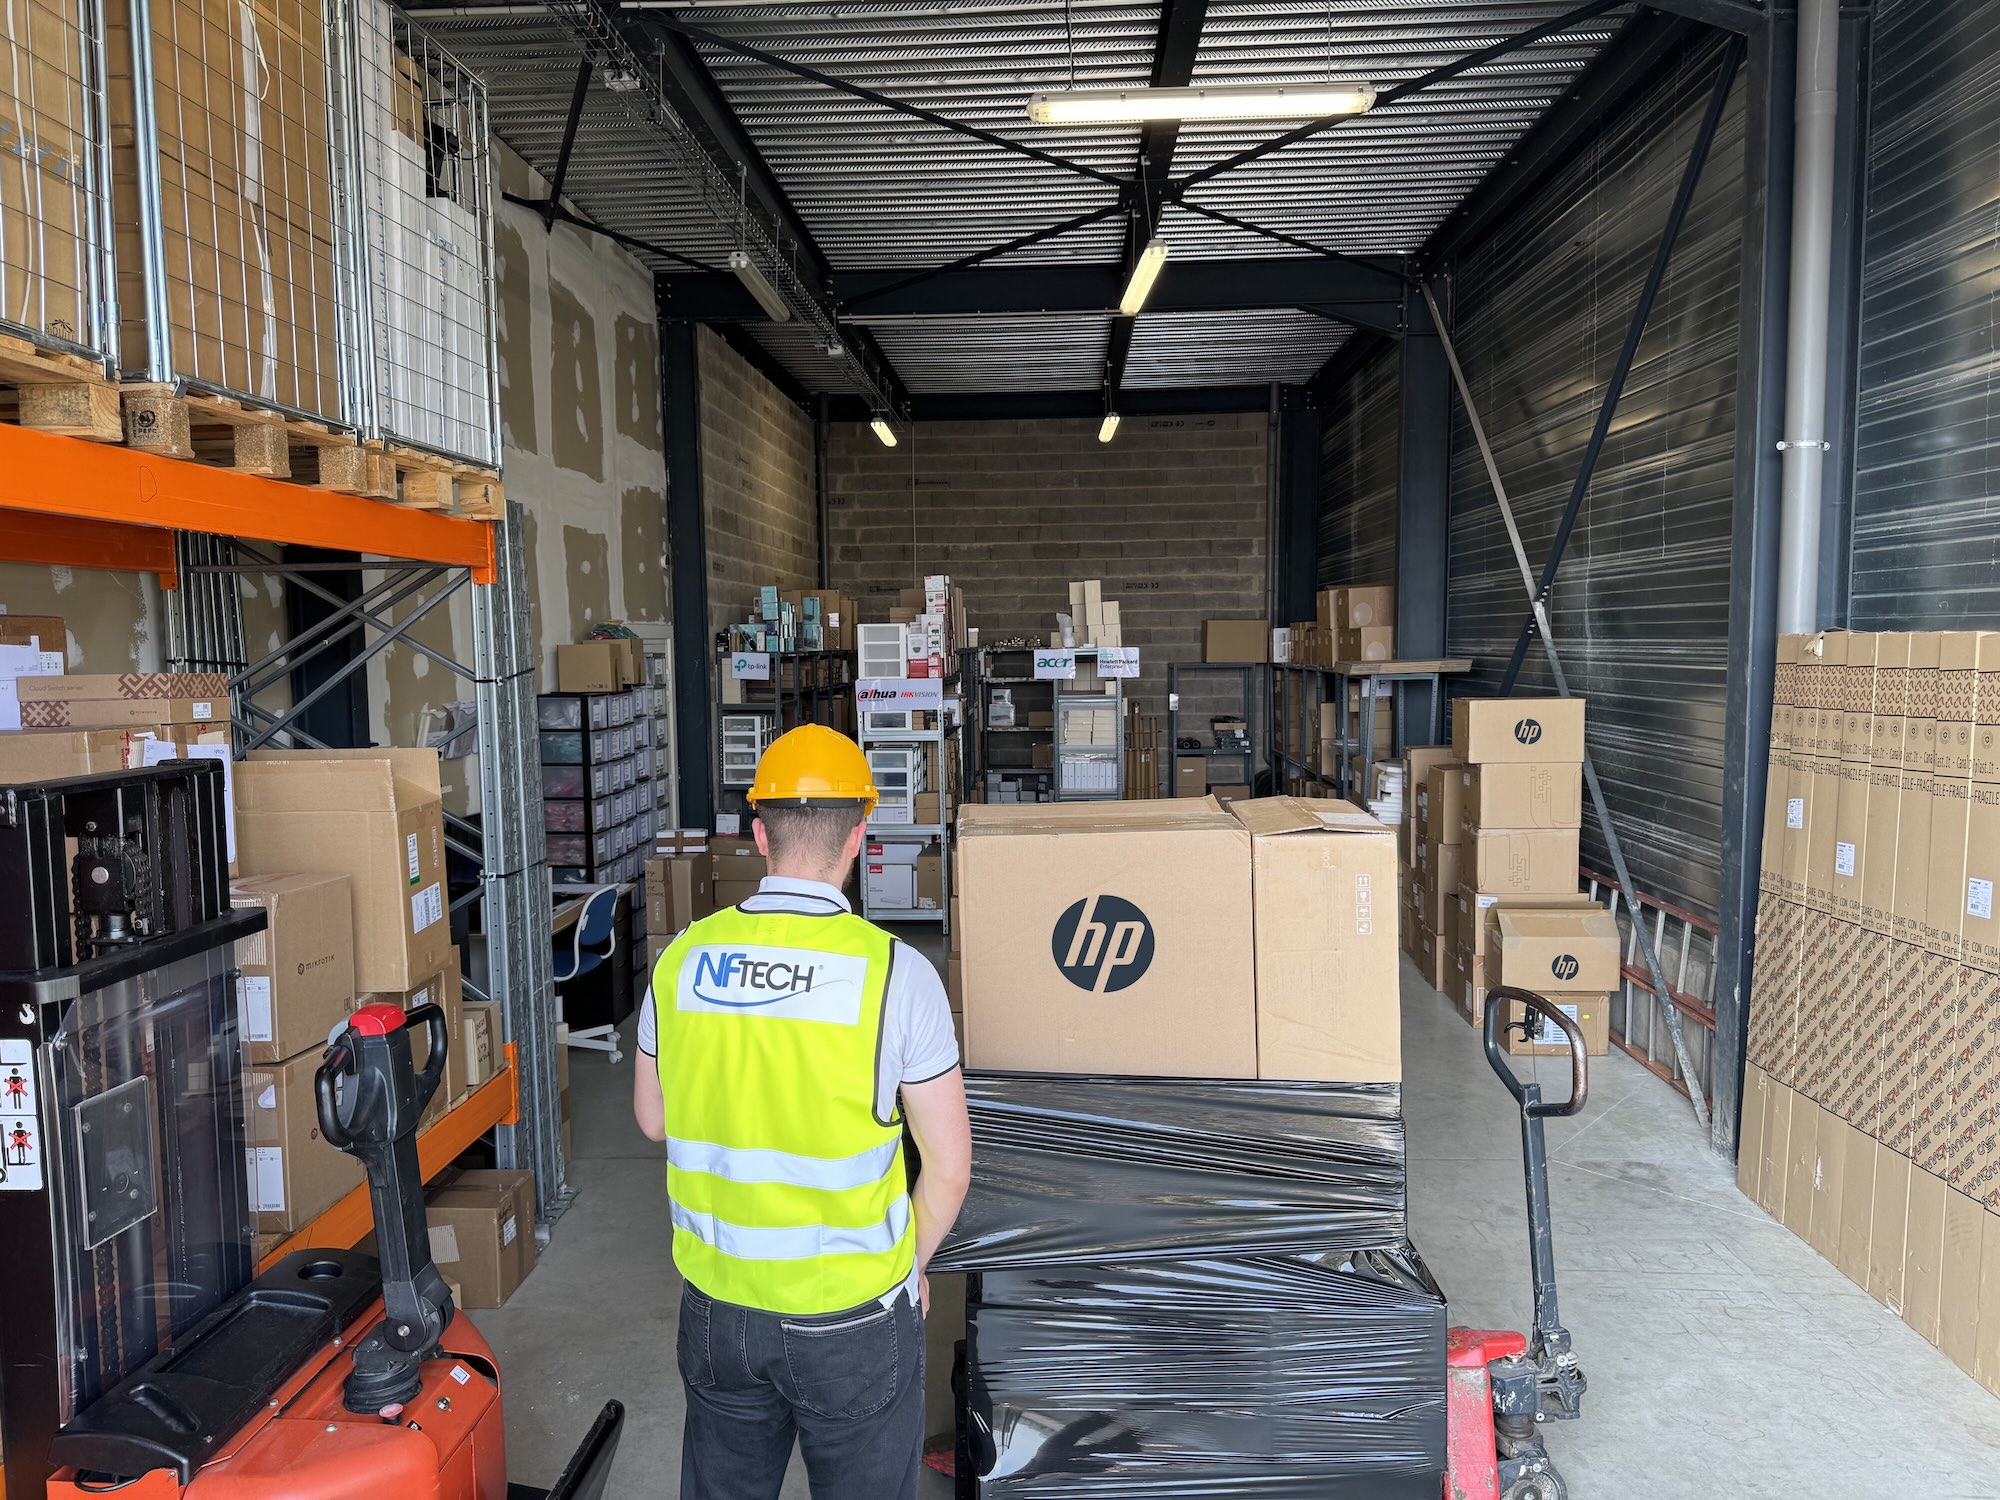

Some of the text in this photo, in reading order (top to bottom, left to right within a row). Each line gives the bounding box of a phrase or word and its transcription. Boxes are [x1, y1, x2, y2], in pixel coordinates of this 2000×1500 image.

[1037, 658, 1072, 667] acer
[1515, 719, 1541, 745] hp
[1058, 895, 1150, 992] hp
[694, 951, 815, 993] NFTECH
[1552, 954, 1579, 980] hp
